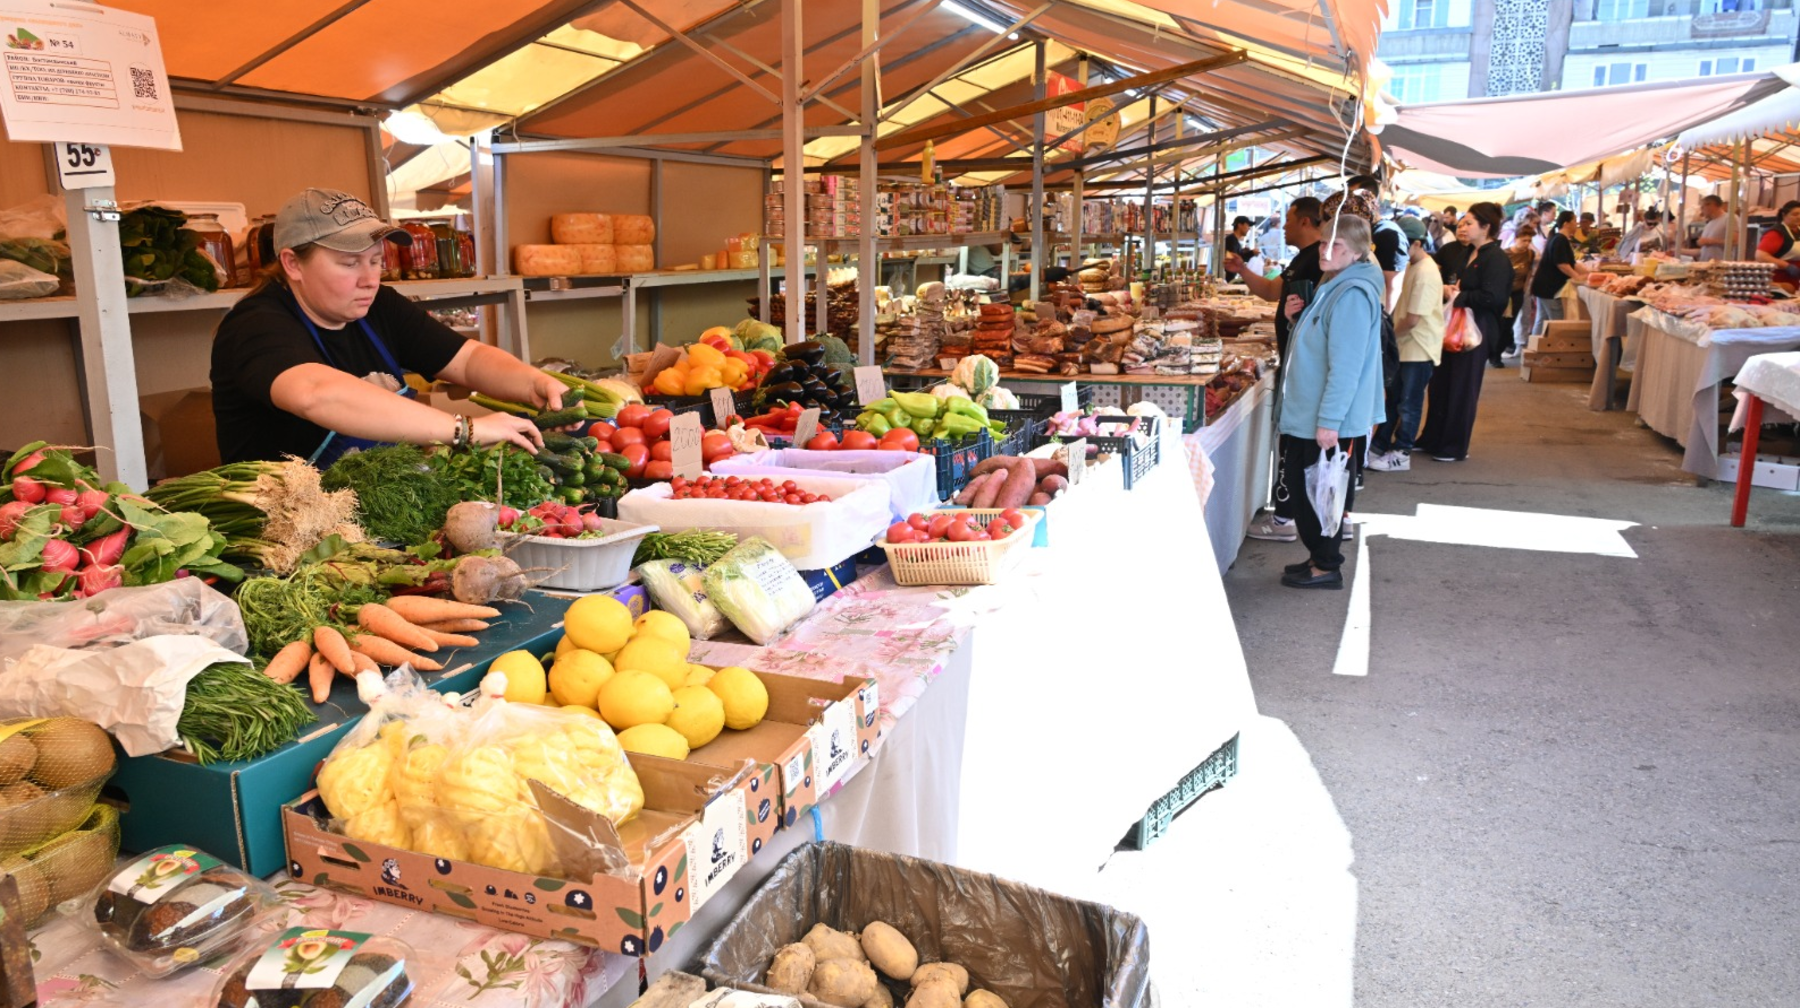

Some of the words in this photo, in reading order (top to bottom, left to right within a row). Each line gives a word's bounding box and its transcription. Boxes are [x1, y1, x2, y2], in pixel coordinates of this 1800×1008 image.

[62, 40, 74, 49] 54
[67, 142, 95, 167] 55
[826, 751, 848, 776] IMBERRY
[705, 852, 736, 887] IMBERRY
[372, 886, 423, 905] IMBERRY
